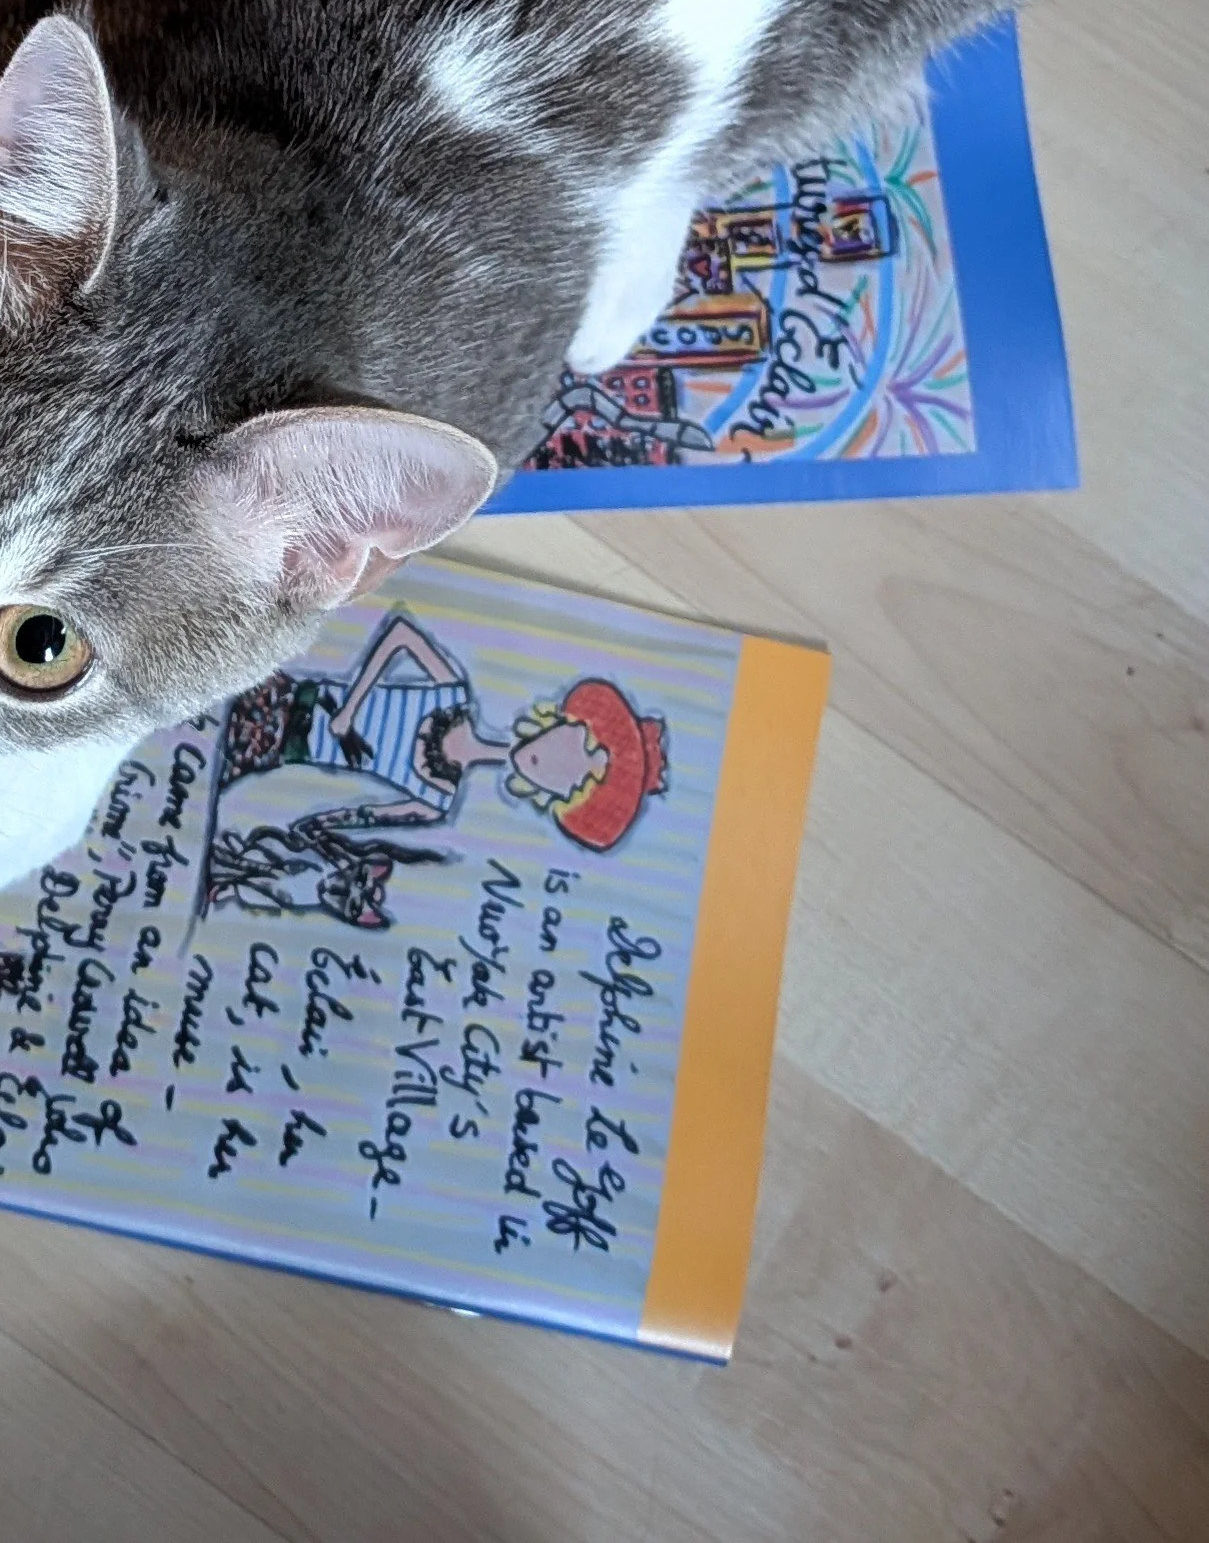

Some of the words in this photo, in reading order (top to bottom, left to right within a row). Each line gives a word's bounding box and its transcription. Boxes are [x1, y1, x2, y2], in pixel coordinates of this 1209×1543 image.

[140, 834, 190, 908] from
[544, 867, 581, 895] is
[130, 925, 162, 975] an
[538, 905, 563, 952] an
[400, 946, 458, 1034] East
[109, 987, 160, 1078] idea
[519, 968, 565, 1080] artist
[225, 1045, 262, 1094] is
[439, 1023, 502, 1140] City's
[72, 1099, 139, 1148] of
[207, 1117, 258, 1179] her
[504, 1087, 564, 1199] based
[493, 1214, 531, 1255] in
